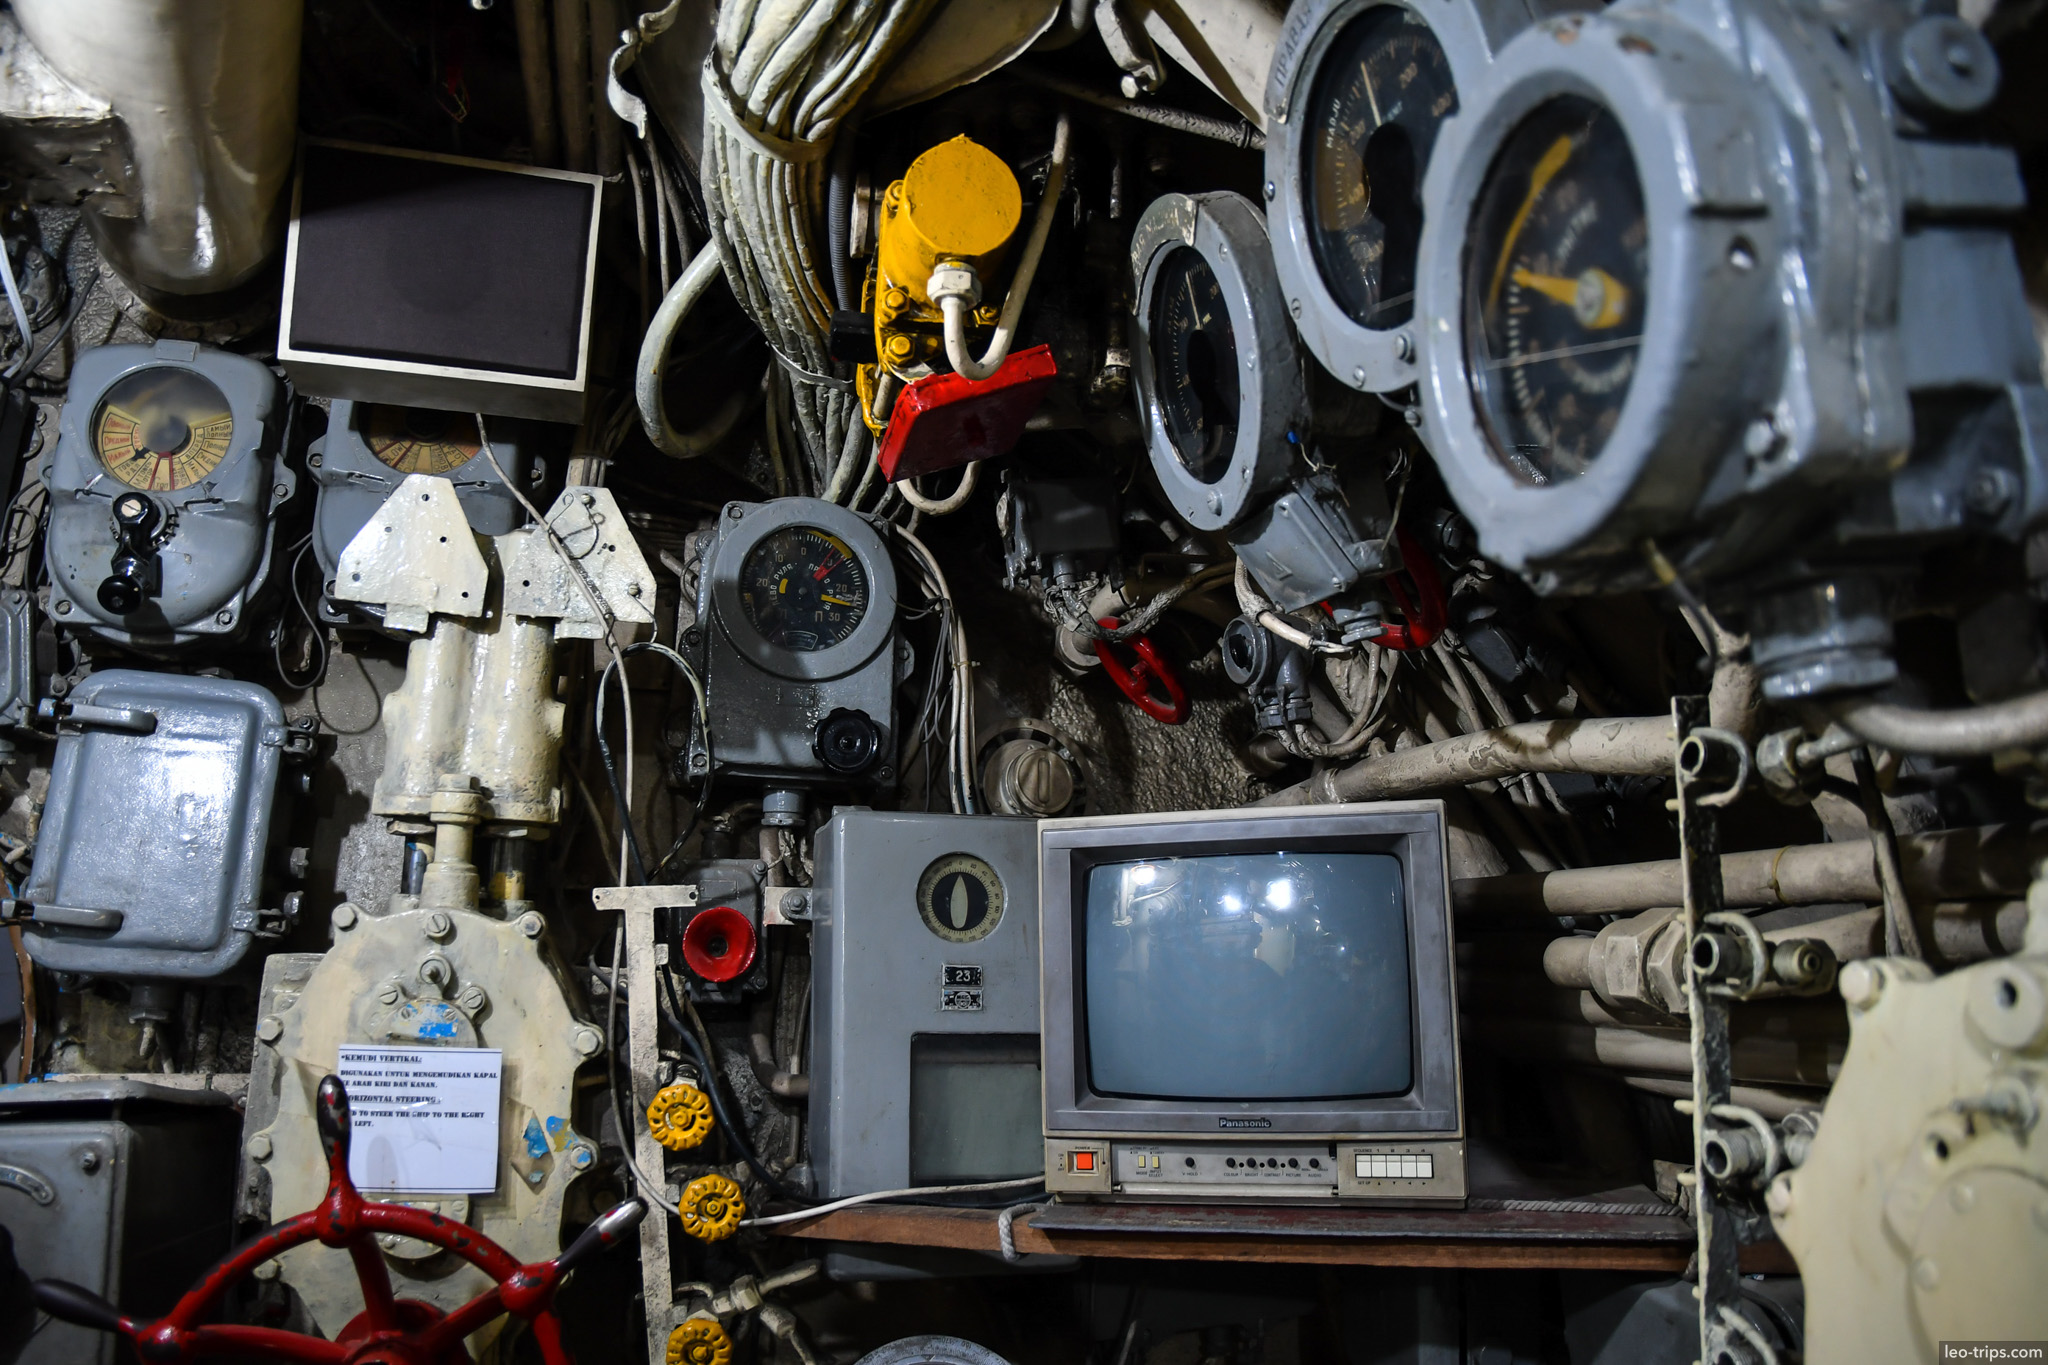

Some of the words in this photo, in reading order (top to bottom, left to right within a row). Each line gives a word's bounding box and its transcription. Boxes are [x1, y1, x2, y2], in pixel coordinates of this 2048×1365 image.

[1326, 98, 1342, 148] MADJU
[801, 547, 807, 556] 0
[774, 563, 794, 581] РУЛЯ
[756, 577, 768, 588] 20
[835, 583, 848, 593] 20
[828, 612, 841, 622] 30
[956, 970, 971, 982] 23
[1220, 1118, 1270, 1127] Panasonic
